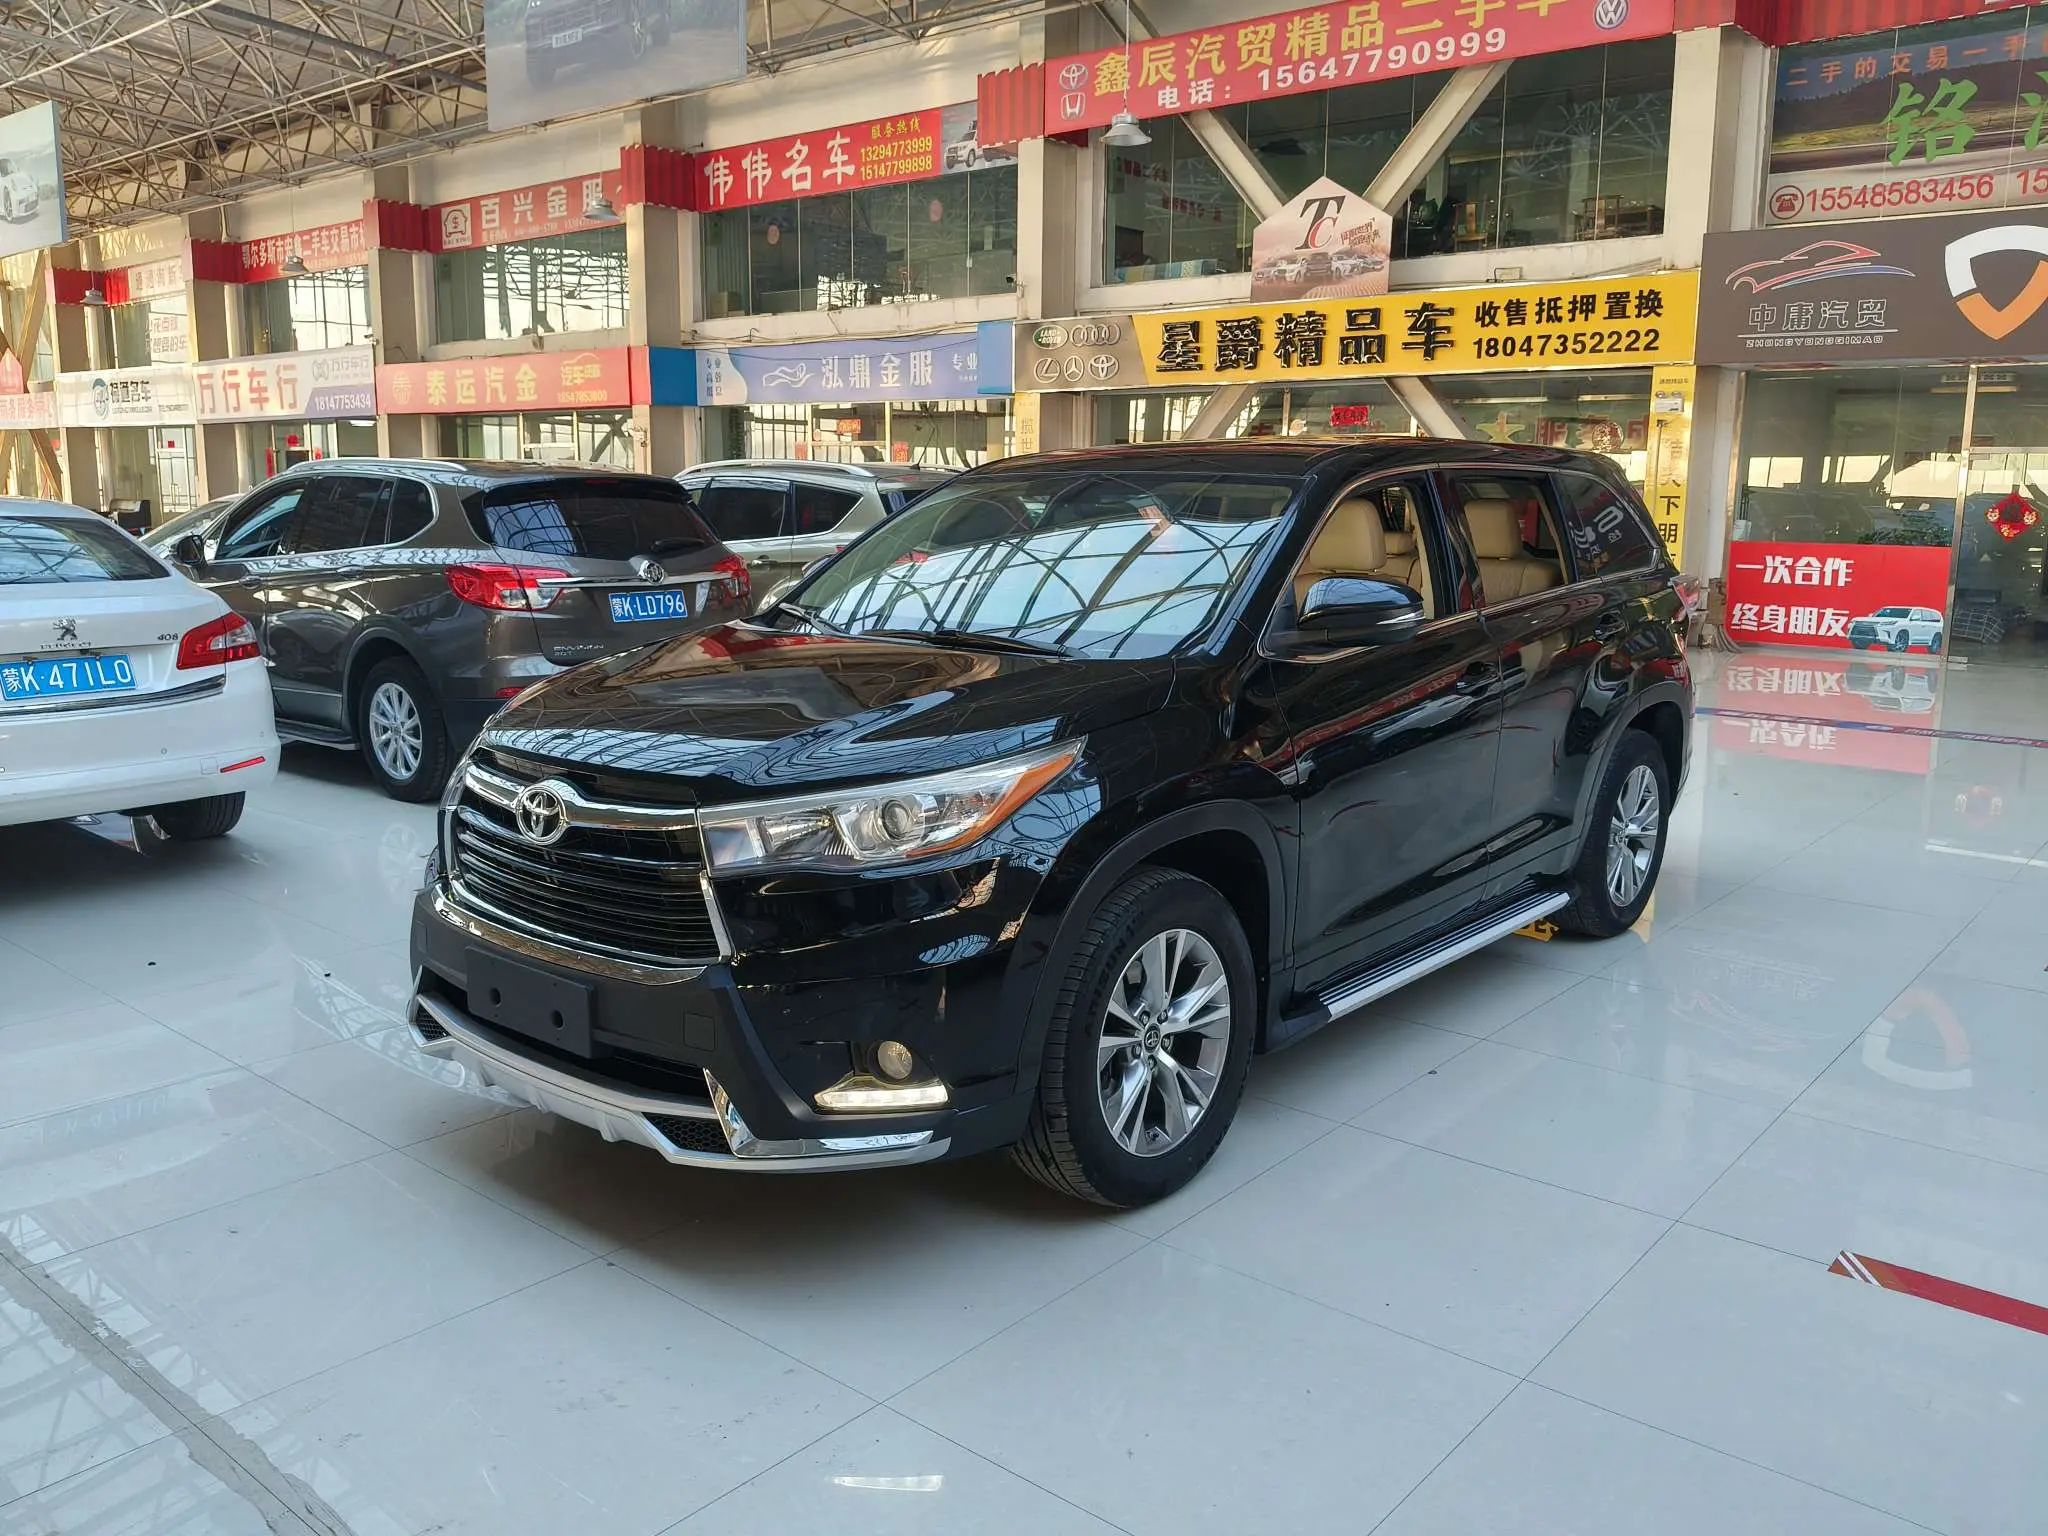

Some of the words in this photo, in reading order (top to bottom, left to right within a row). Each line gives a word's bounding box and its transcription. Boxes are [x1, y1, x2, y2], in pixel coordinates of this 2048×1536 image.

[1257, 27, 1506, 91] 15647790999
[1786, 30, 2048, 87] 二手的交易一手
[871, 115, 921, 139] 服务热线
[860, 136, 932, 162] 13294773999
[860, 155, 932, 181] 15147799898
[704, 131, 855, 206] 伟伟名车
[1806, 175, 1994, 213] 15548583456
[1475, 290, 1663, 328] 收售抵押置换
[1749, 299, 1887, 332] 中庸汽贸
[1156, 302, 1455, 372] 星爵精品车
[1472, 329, 1660, 360] 18047352222
[426, 363, 538, 406] 泰运汽金
[822, 350, 932, 389] 泓鼎金服
[197, 364, 298, 414] 万行车行
[1735, 555, 1854, 588] 一次合作
[1731, 603, 1851, 638] 终身朋友
